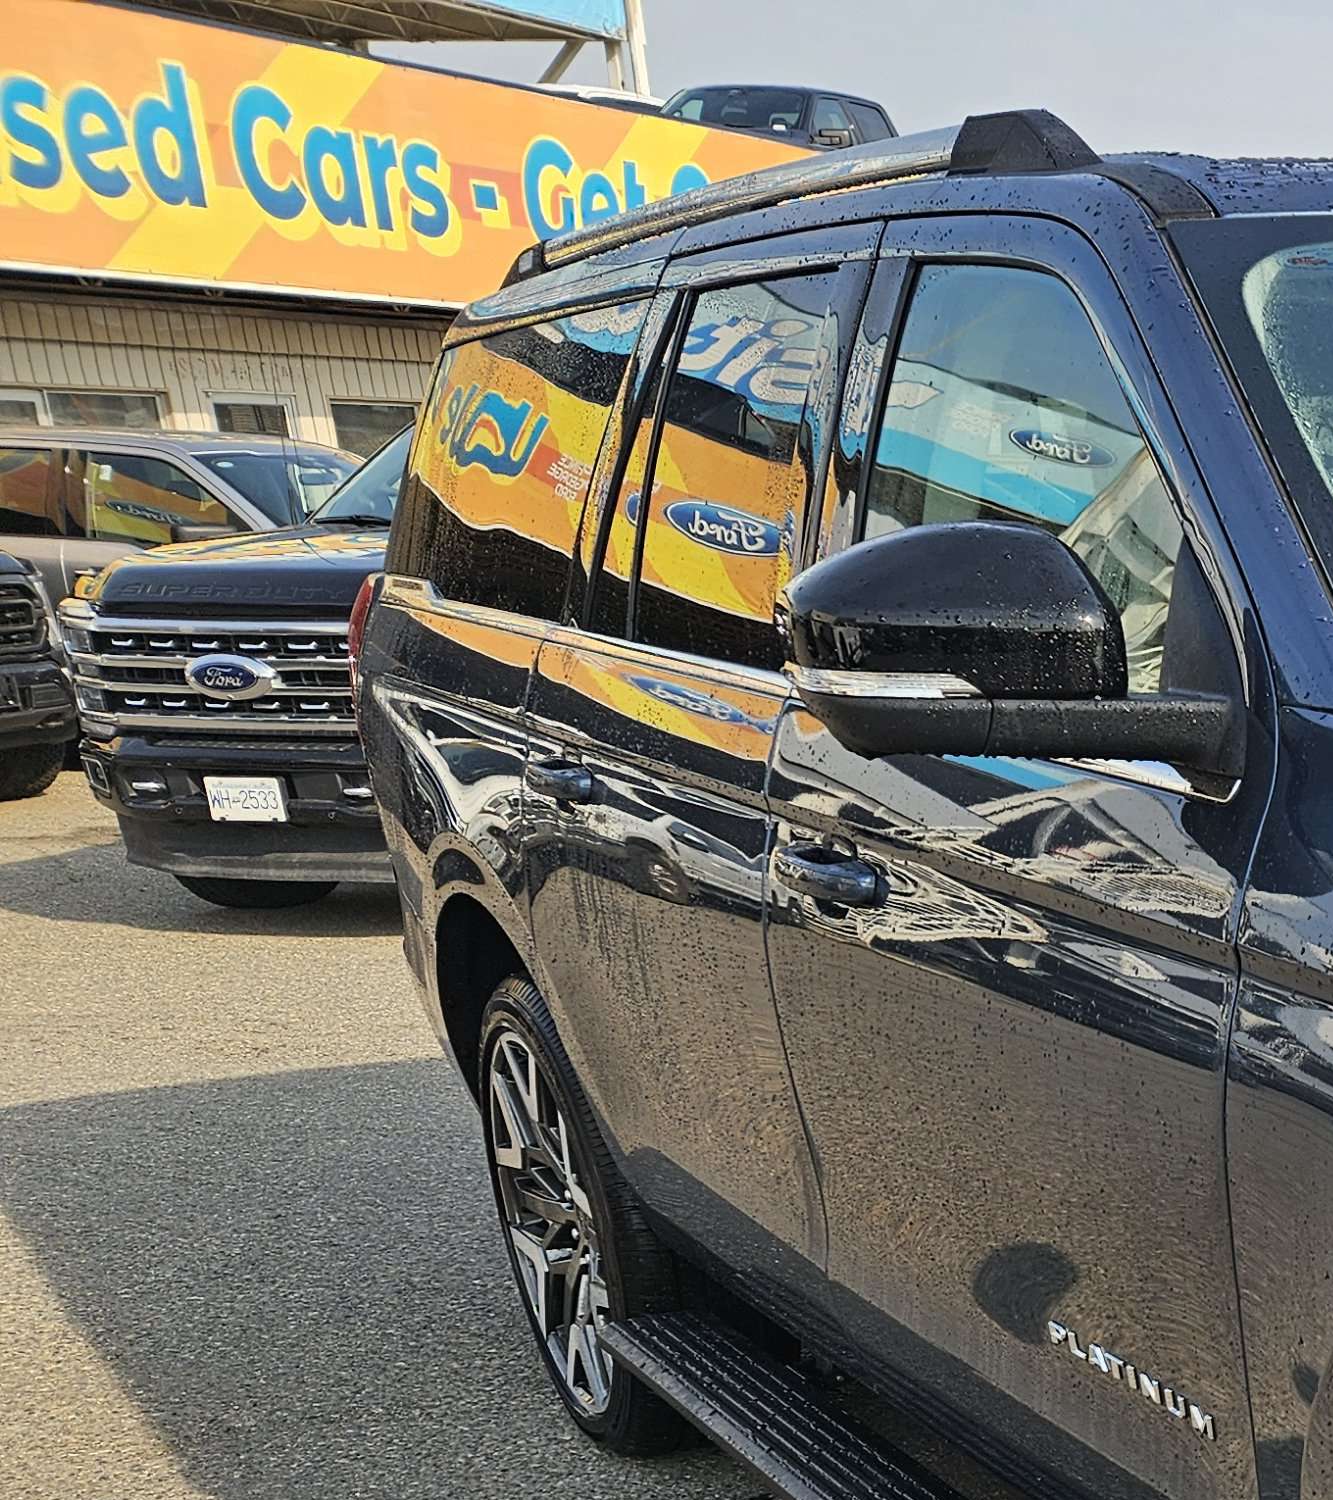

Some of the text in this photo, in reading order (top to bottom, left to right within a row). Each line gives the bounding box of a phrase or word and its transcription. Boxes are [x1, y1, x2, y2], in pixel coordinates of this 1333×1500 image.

[232, 85, 450, 238] Cars
[524, 137, 645, 240] Get
[203, 666, 245, 688] Ford
[209, 789, 279, 809] WH-2533
[1047, 1320, 1215, 1441] PLATINUM
